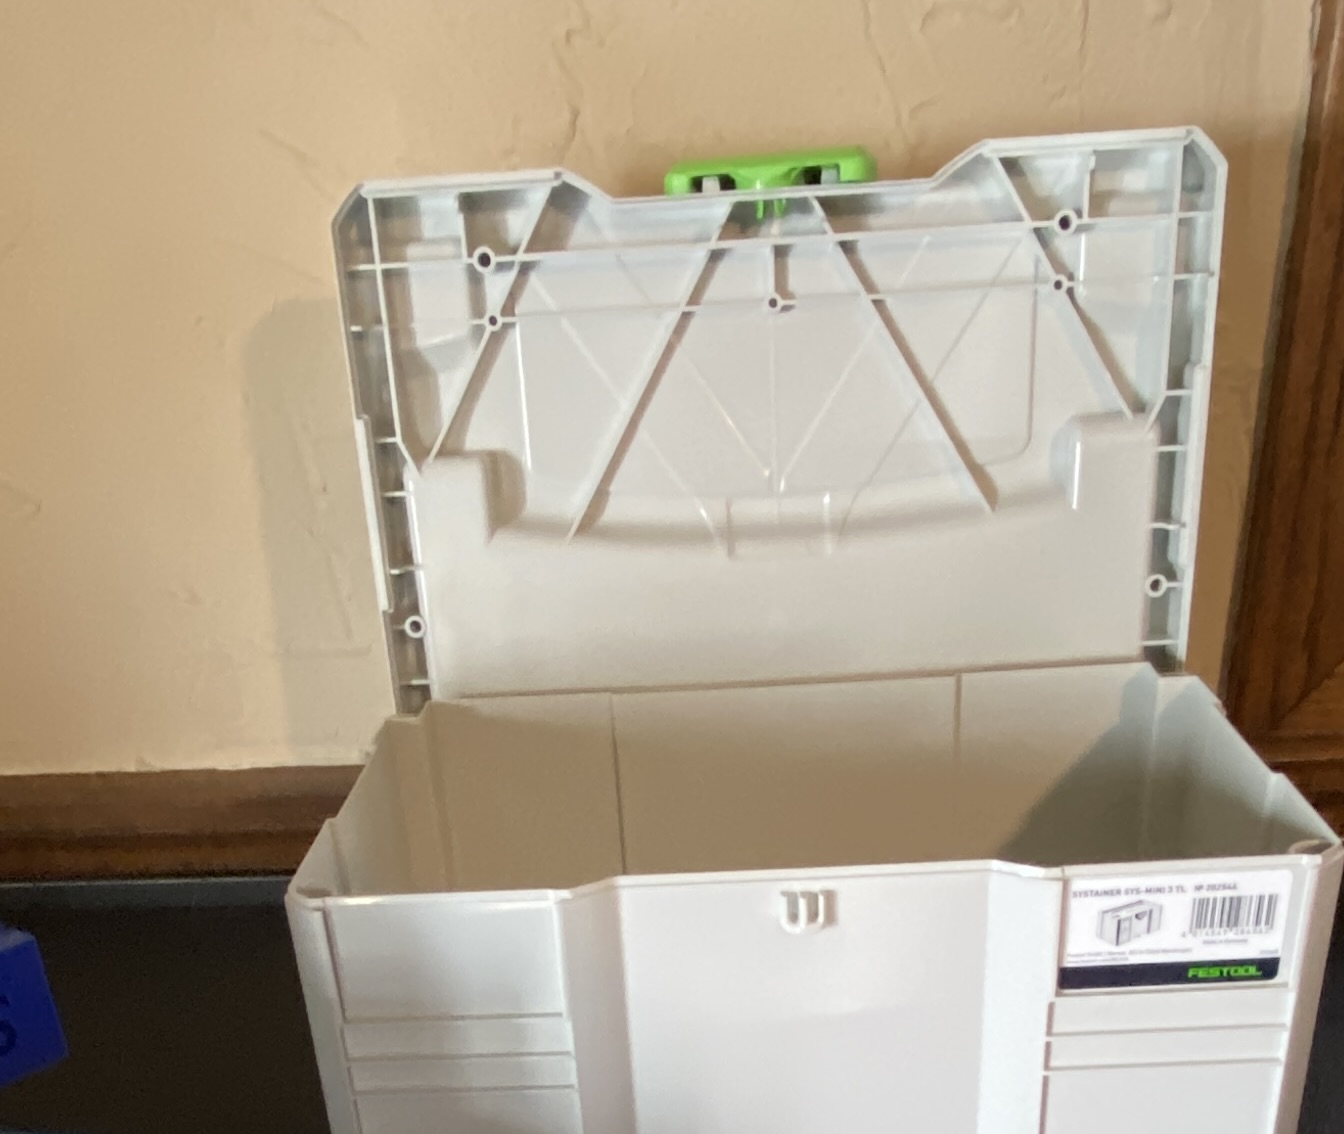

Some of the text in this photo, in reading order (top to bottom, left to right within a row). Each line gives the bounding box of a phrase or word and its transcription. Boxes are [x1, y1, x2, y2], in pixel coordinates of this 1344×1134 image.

[1072, 888, 1122, 898] SYSTAINER
[1175, 885, 1186, 893] TL
[1187, 965, 1263, 979] FESTOOL
